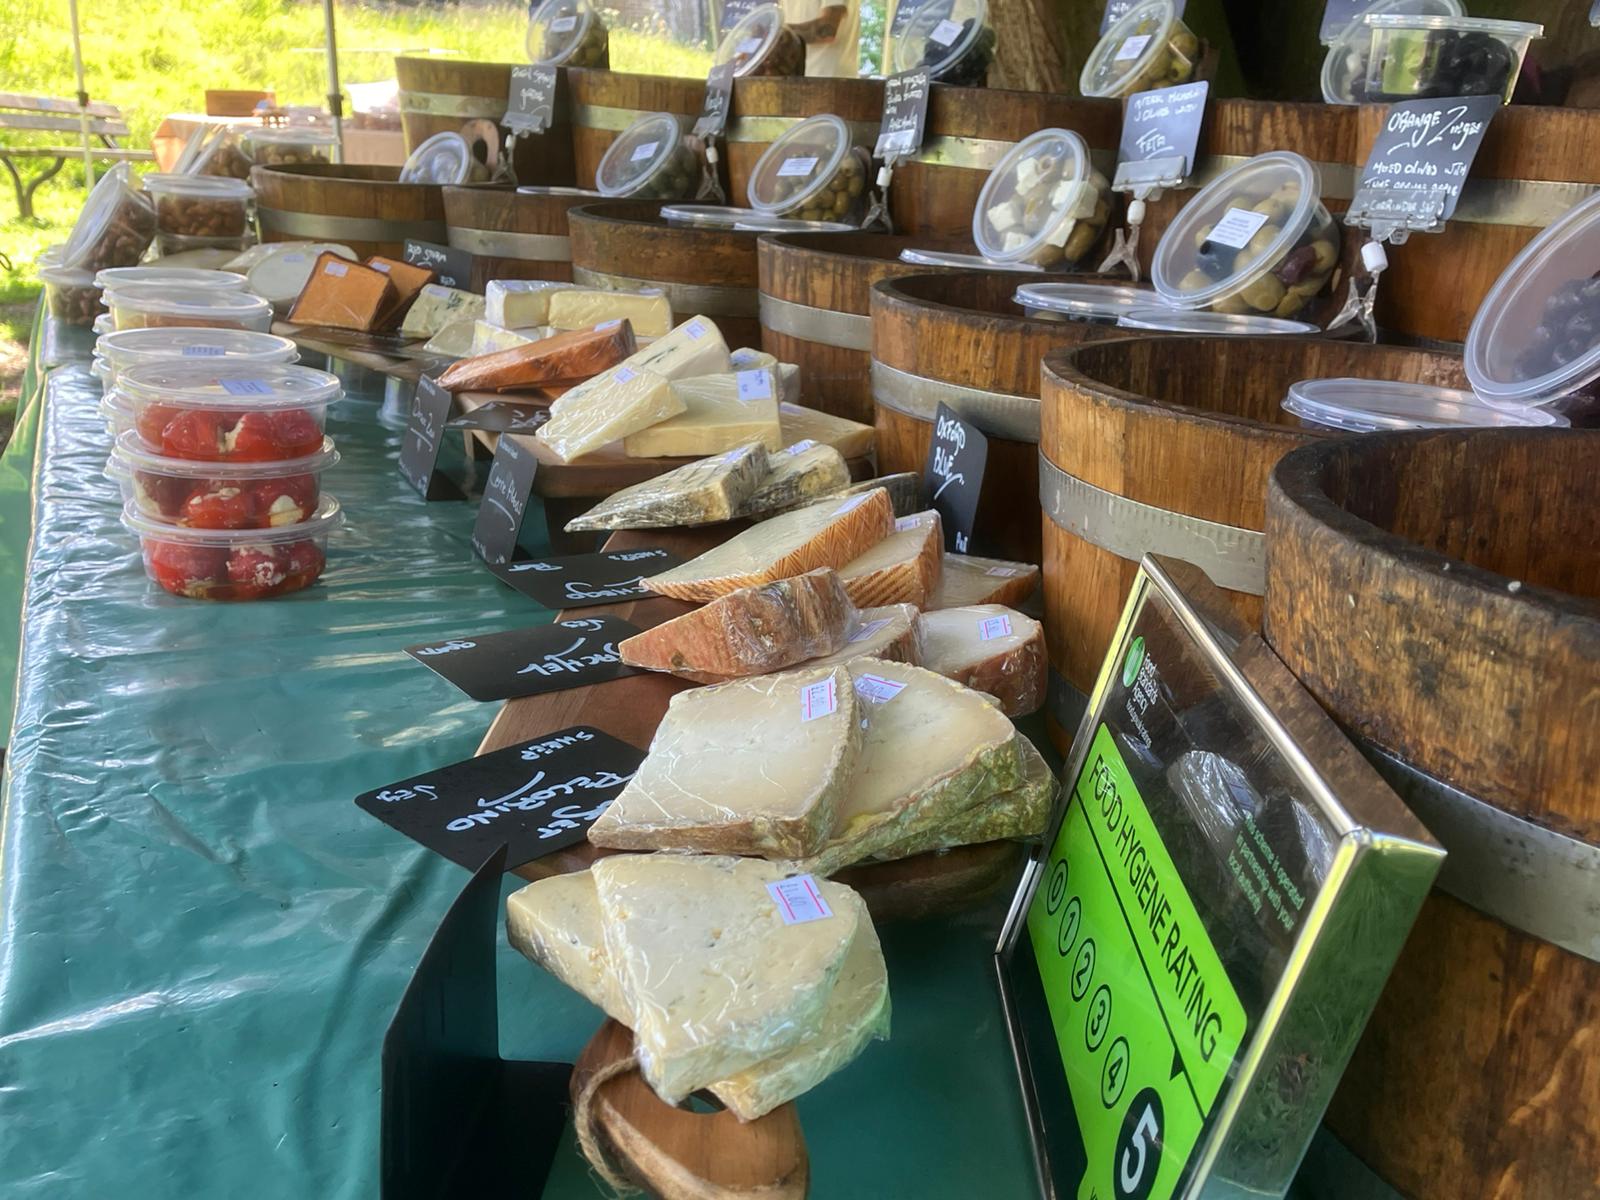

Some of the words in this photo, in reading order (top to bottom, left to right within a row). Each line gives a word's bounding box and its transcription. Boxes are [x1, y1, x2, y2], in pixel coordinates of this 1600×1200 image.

[1132, 681, 1148, 715] Agency
[1138, 667, 1158, 705] Standards
[520, 730, 596, 761] SHEEP
[1254, 830, 1275, 864] scheme
[1277, 867, 1305, 911] operated
[1089, 754, 1123, 832] FOOD
[1115, 816, 1171, 945] HYGIENE
[1161, 921, 1222, 1063] RATING
[1120, 1102, 1159, 1194] 5
